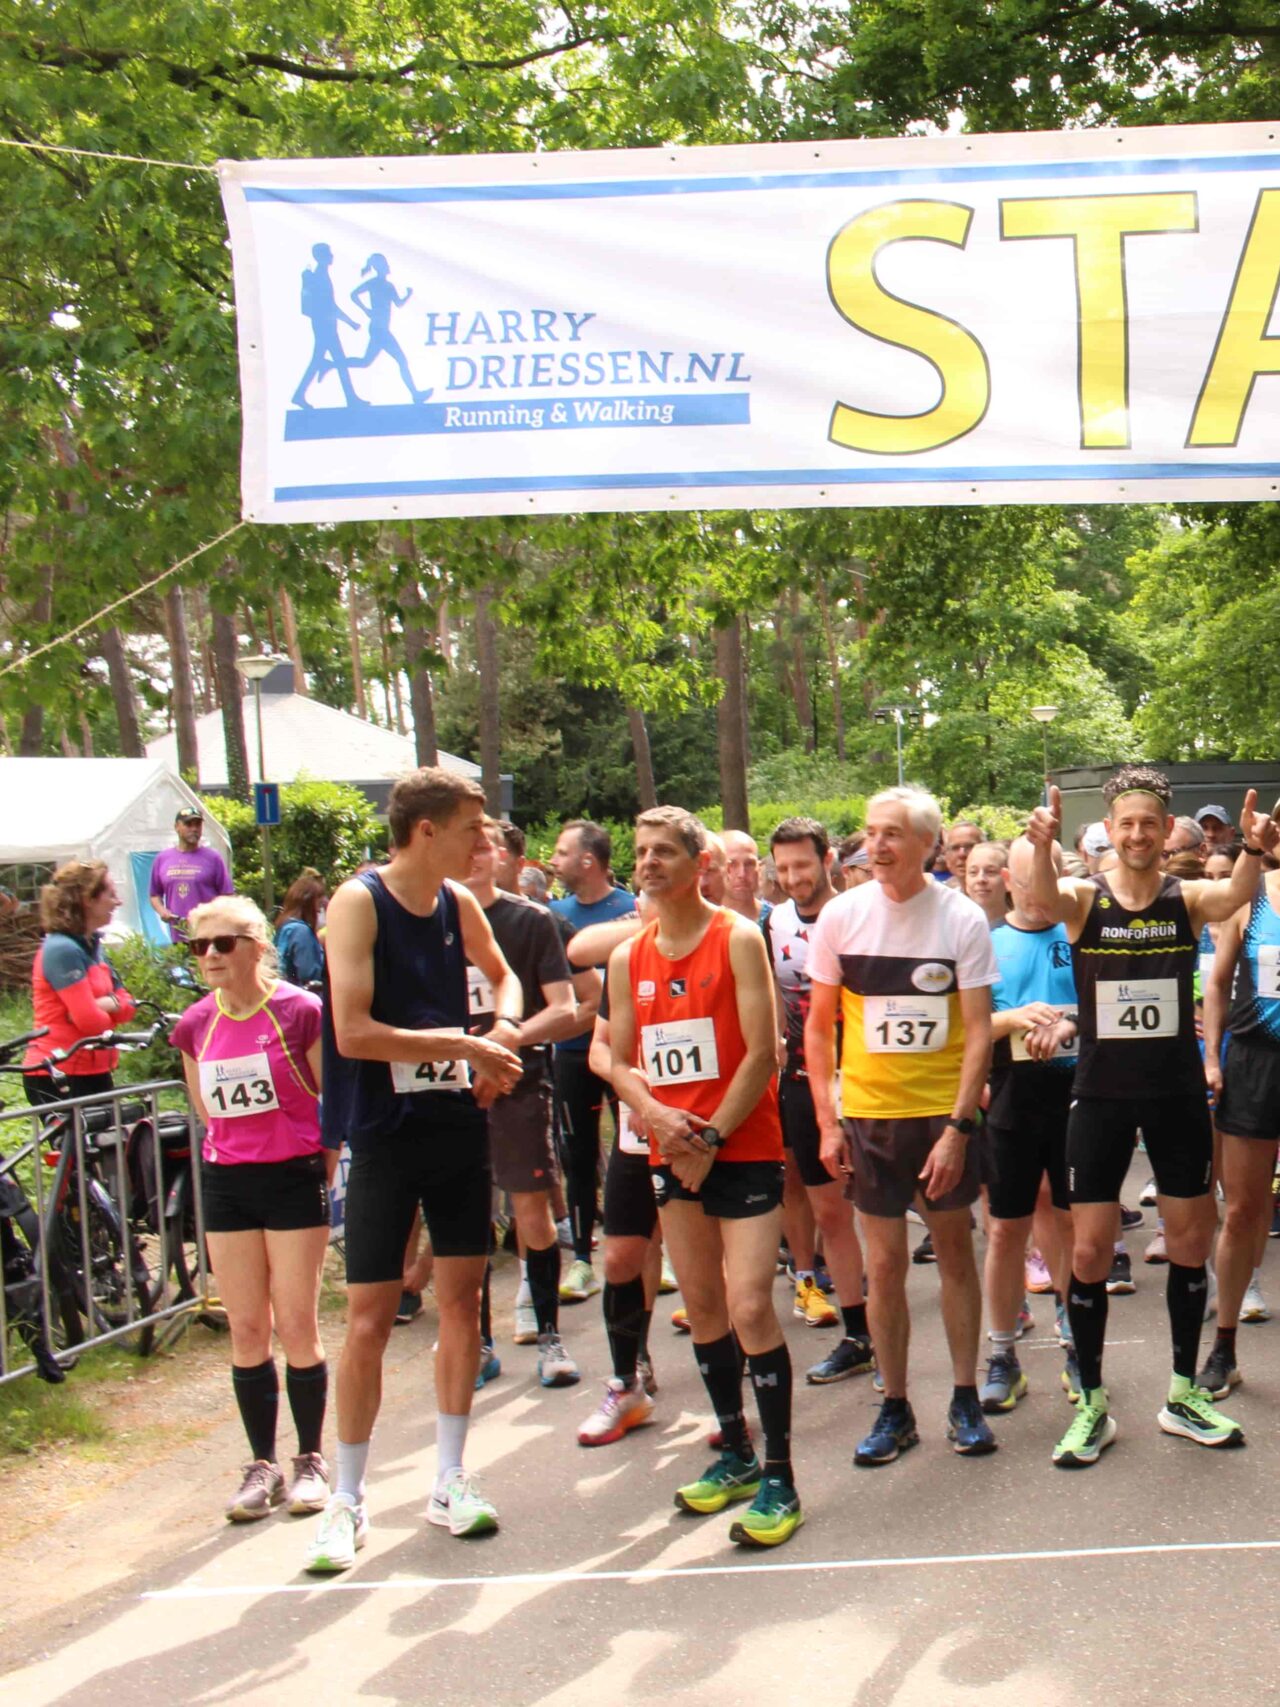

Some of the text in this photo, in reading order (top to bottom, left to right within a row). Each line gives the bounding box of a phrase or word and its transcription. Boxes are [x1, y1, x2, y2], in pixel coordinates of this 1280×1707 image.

[424, 309, 597, 346] HARRY
[445, 350, 752, 391] DRIESSEN.NL
[444, 400, 675, 428] Running & Walking
[1118, 1005, 1160, 1031] 40
[876, 1021, 937, 1046] 137
[415, 1060, 457, 1083] 42
[651, 1046, 702, 1077] 101
[211, 1079, 274, 1111] 143
